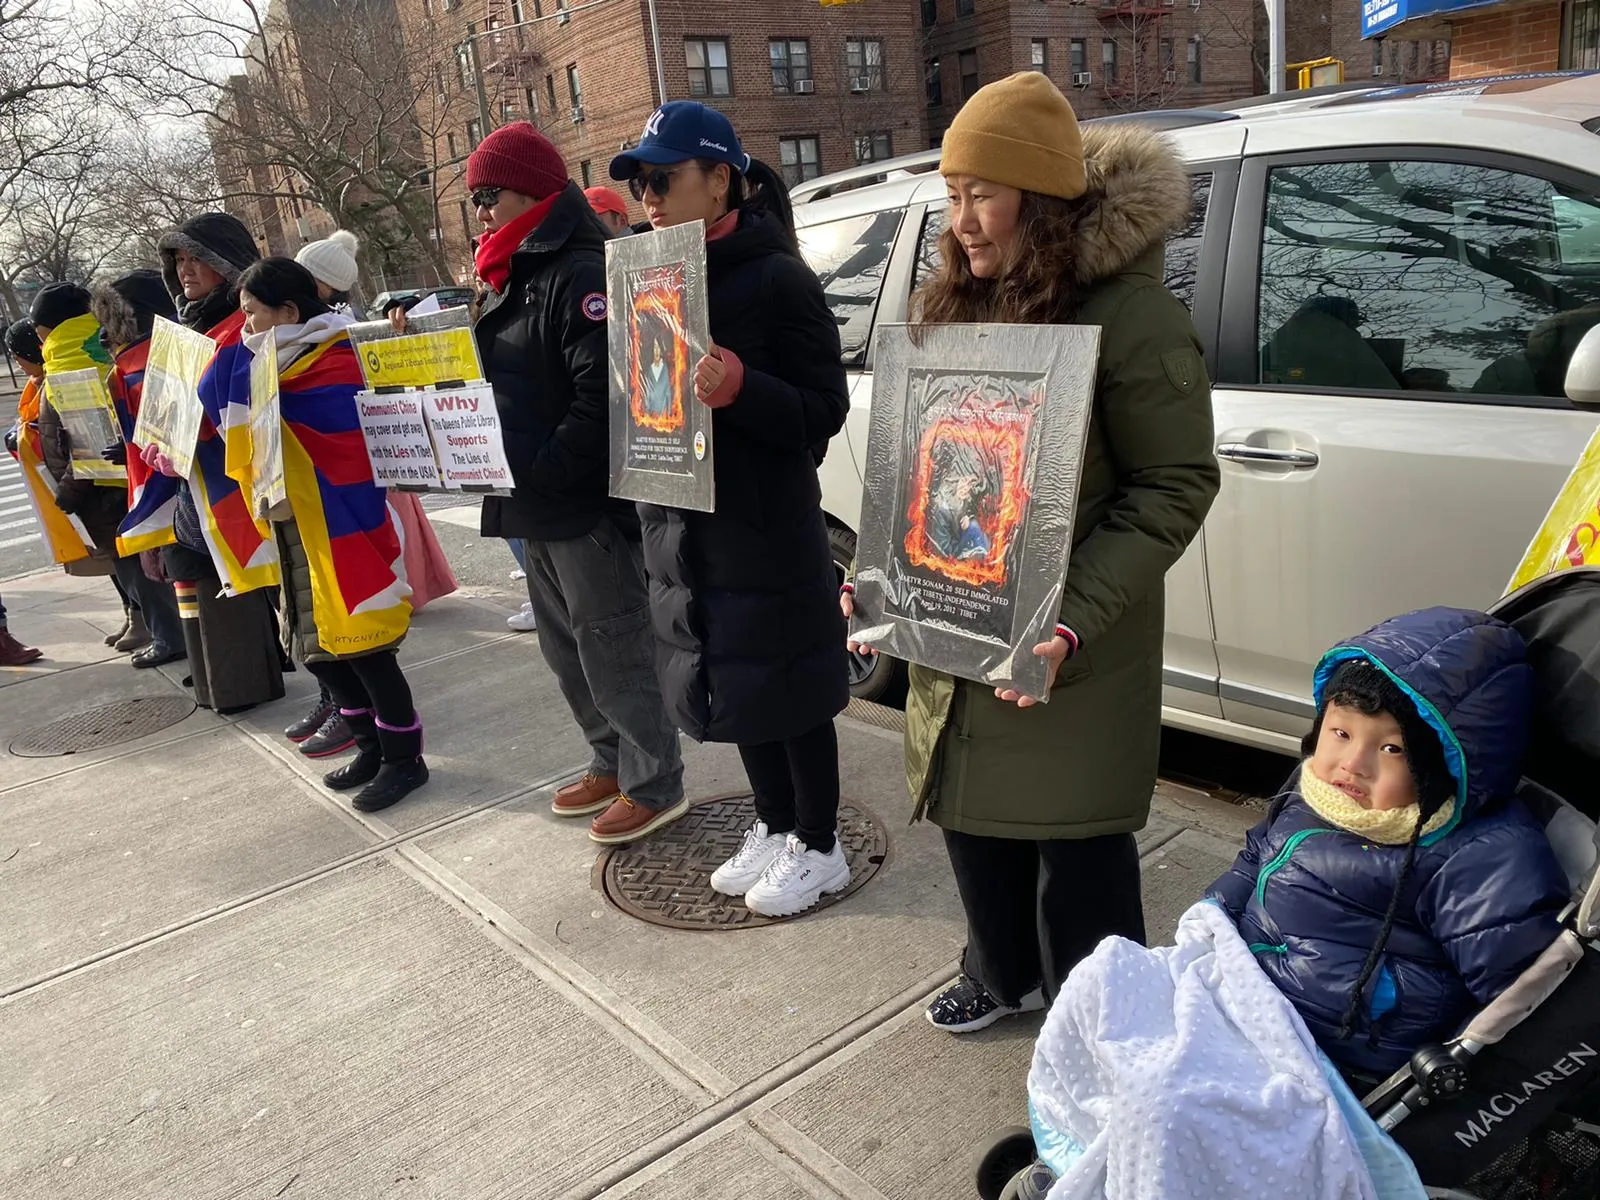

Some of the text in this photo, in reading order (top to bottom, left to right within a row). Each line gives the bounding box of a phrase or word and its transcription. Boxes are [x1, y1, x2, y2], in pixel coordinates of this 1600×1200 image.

[699, 138, 728, 153] Yankees
[361, 400, 418, 417] Communist China
[433, 396, 479, 412] Why
[441, 417, 460, 430] Queens
[460, 415, 477, 429] Public
[476, 414, 497, 430] Library
[364, 421, 424, 439] may cover and get away
[446, 434, 488, 449] Supports
[370, 444, 433, 459] with the Lies in Tibet
[451, 451, 491, 465] The Lies of
[376, 465, 437, 479] but not in the USA!
[446, 467, 507, 481] Communist China?
[910, 585, 922, 595] FOR
[945, 594, 992, 613] INDEPENDENCE
[922, 578, 945, 592] SONAM,
[954, 586, 971, 597] SELF
[970, 589, 1009, 606] IMMOLATED
[942, 605, 956, 614] 2012
[960, 608, 978, 620] TIBET
[1454, 1042, 1598, 1148] MACLAREN
